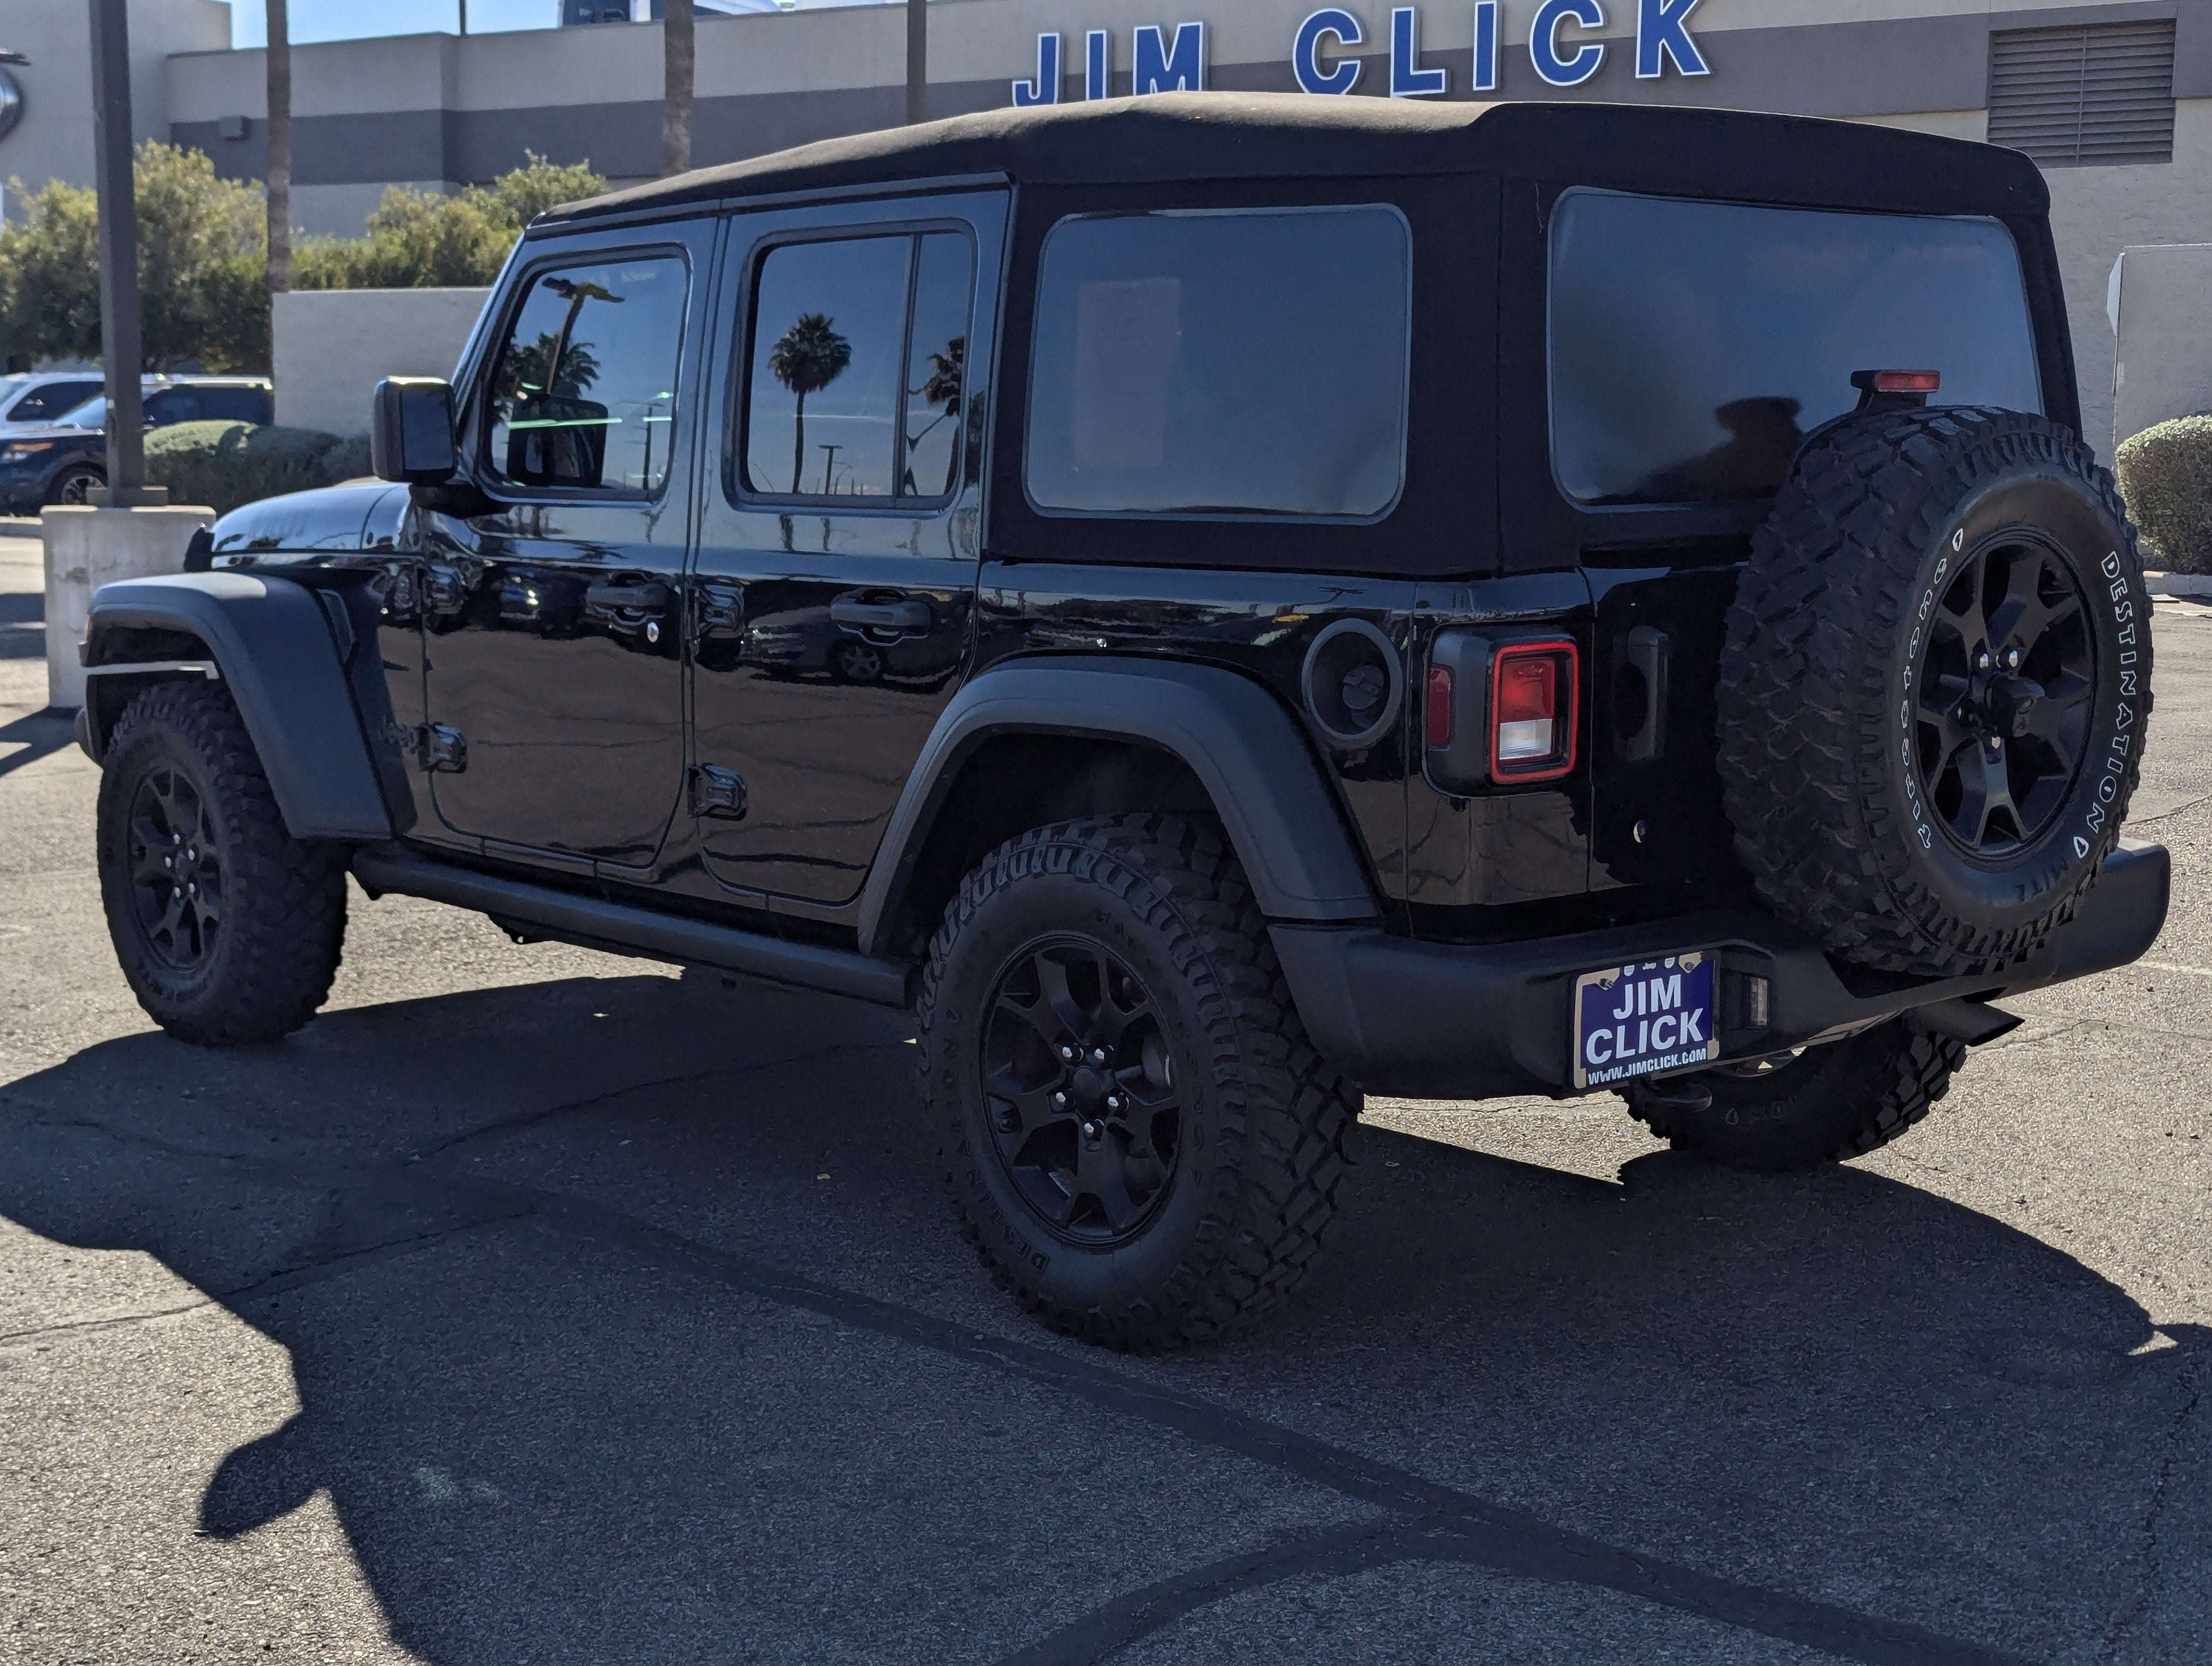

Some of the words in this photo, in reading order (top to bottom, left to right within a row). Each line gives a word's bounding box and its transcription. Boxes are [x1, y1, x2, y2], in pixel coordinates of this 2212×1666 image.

[1012, 22, 1204, 107] JIM
[1291, 0, 1713, 97] CLICK
[2086, 550, 2137, 834] DESTINATION
[1612, 973, 1682, 1020] JIM
[1586, 1008, 1704, 1065] CLICK
[1588, 1047, 1707, 1086] WWW.JIMCLICK.COM
